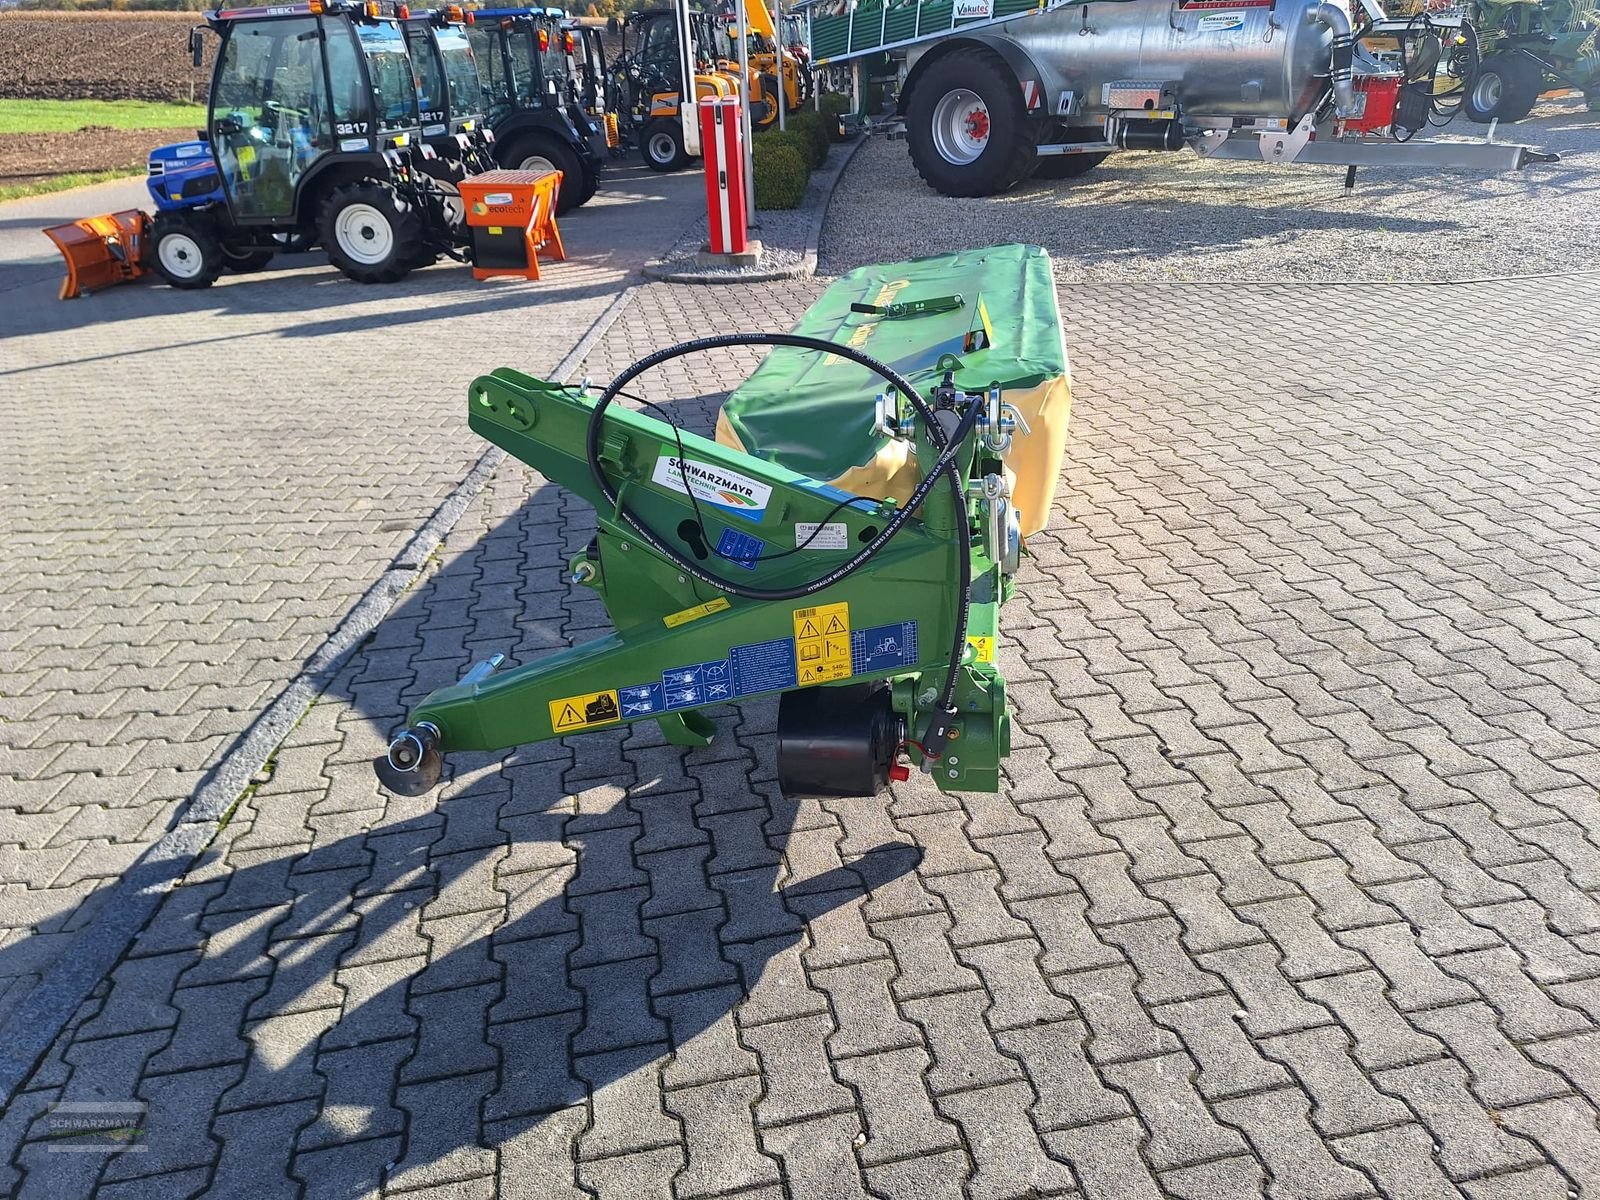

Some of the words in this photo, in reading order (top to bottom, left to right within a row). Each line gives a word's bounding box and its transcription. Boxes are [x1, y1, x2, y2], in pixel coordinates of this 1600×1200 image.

[266, 7, 295, 15] ISEKI
[337, 122, 368, 134] 3217
[489, 205, 525, 214] ecotech
[667, 468, 717, 492] LANTECHNIK
[668, 457, 753, 498] SCHWARZMAYR
[832, 562, 855, 580] MUELLER
[853, 549, 872, 565] RHEINE
